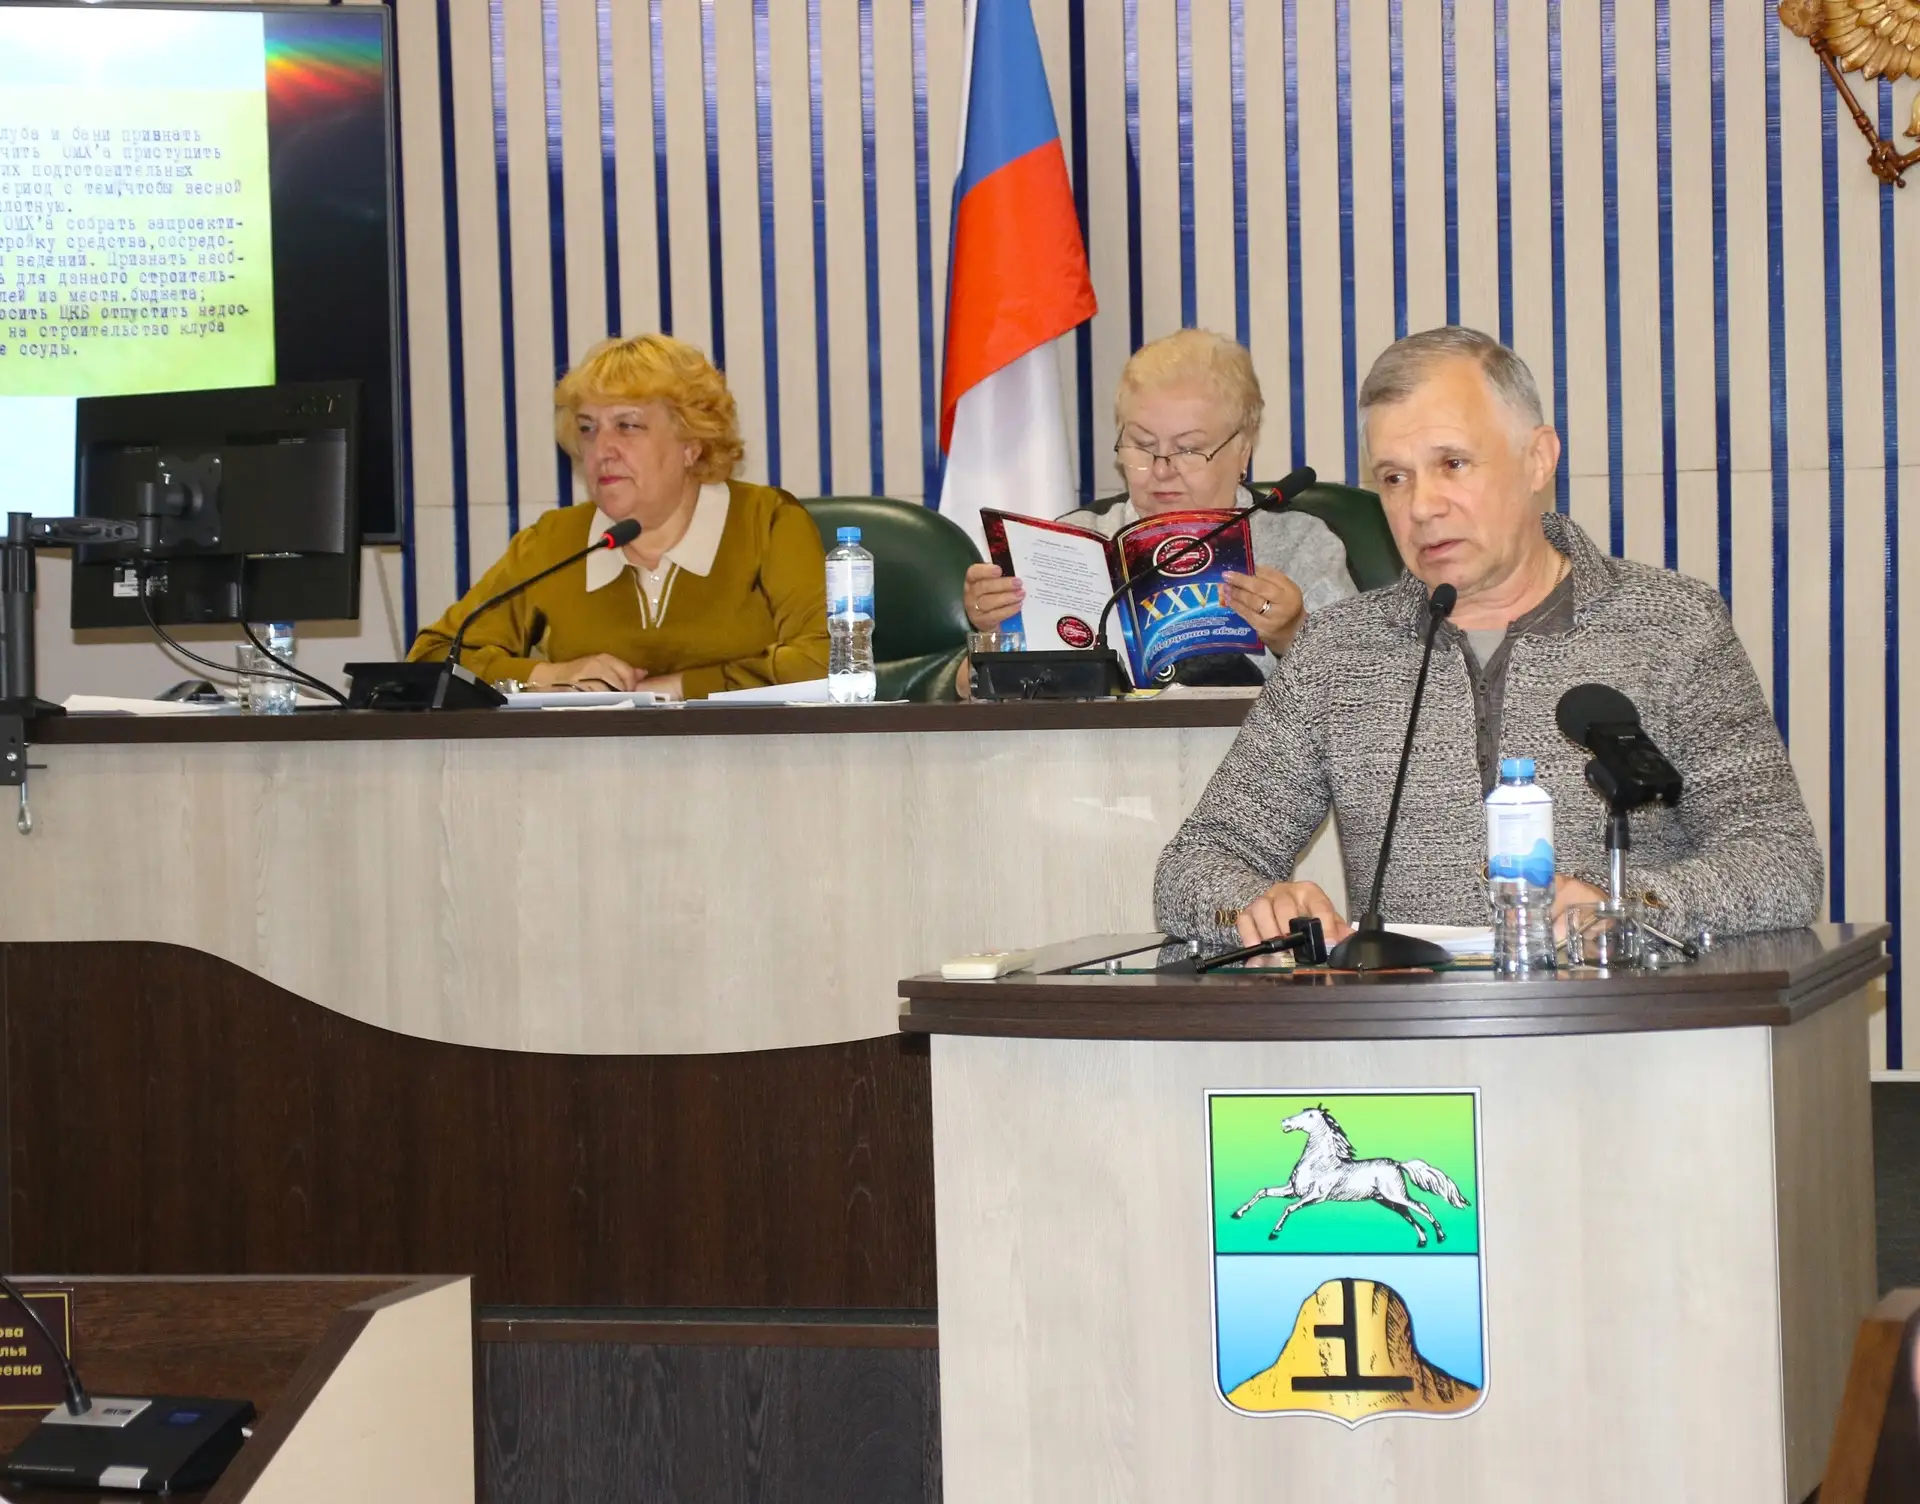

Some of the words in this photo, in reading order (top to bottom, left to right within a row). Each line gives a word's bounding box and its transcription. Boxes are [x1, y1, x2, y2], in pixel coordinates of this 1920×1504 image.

[72, 126, 110, 141] бани
[123, 147, 221, 162] приступить
[32, 164, 193, 179] подготовительных
[185, 178, 242, 194] весной
[0, 201, 72, 217] лотную.
[66, 216, 136, 234] собрать
[16, 272, 46, 288] для
[59, 271, 128, 287] данного
[139, 270, 235, 287] строитель-
[100, 306, 188, 323] отпустить
[8, 326, 27, 338] на
[38, 324, 169, 340] строительство
[180, 319, 225, 338] клуба
[19, 343, 77, 359] ссуды.
[0, 1365, 42, 1376] евна
